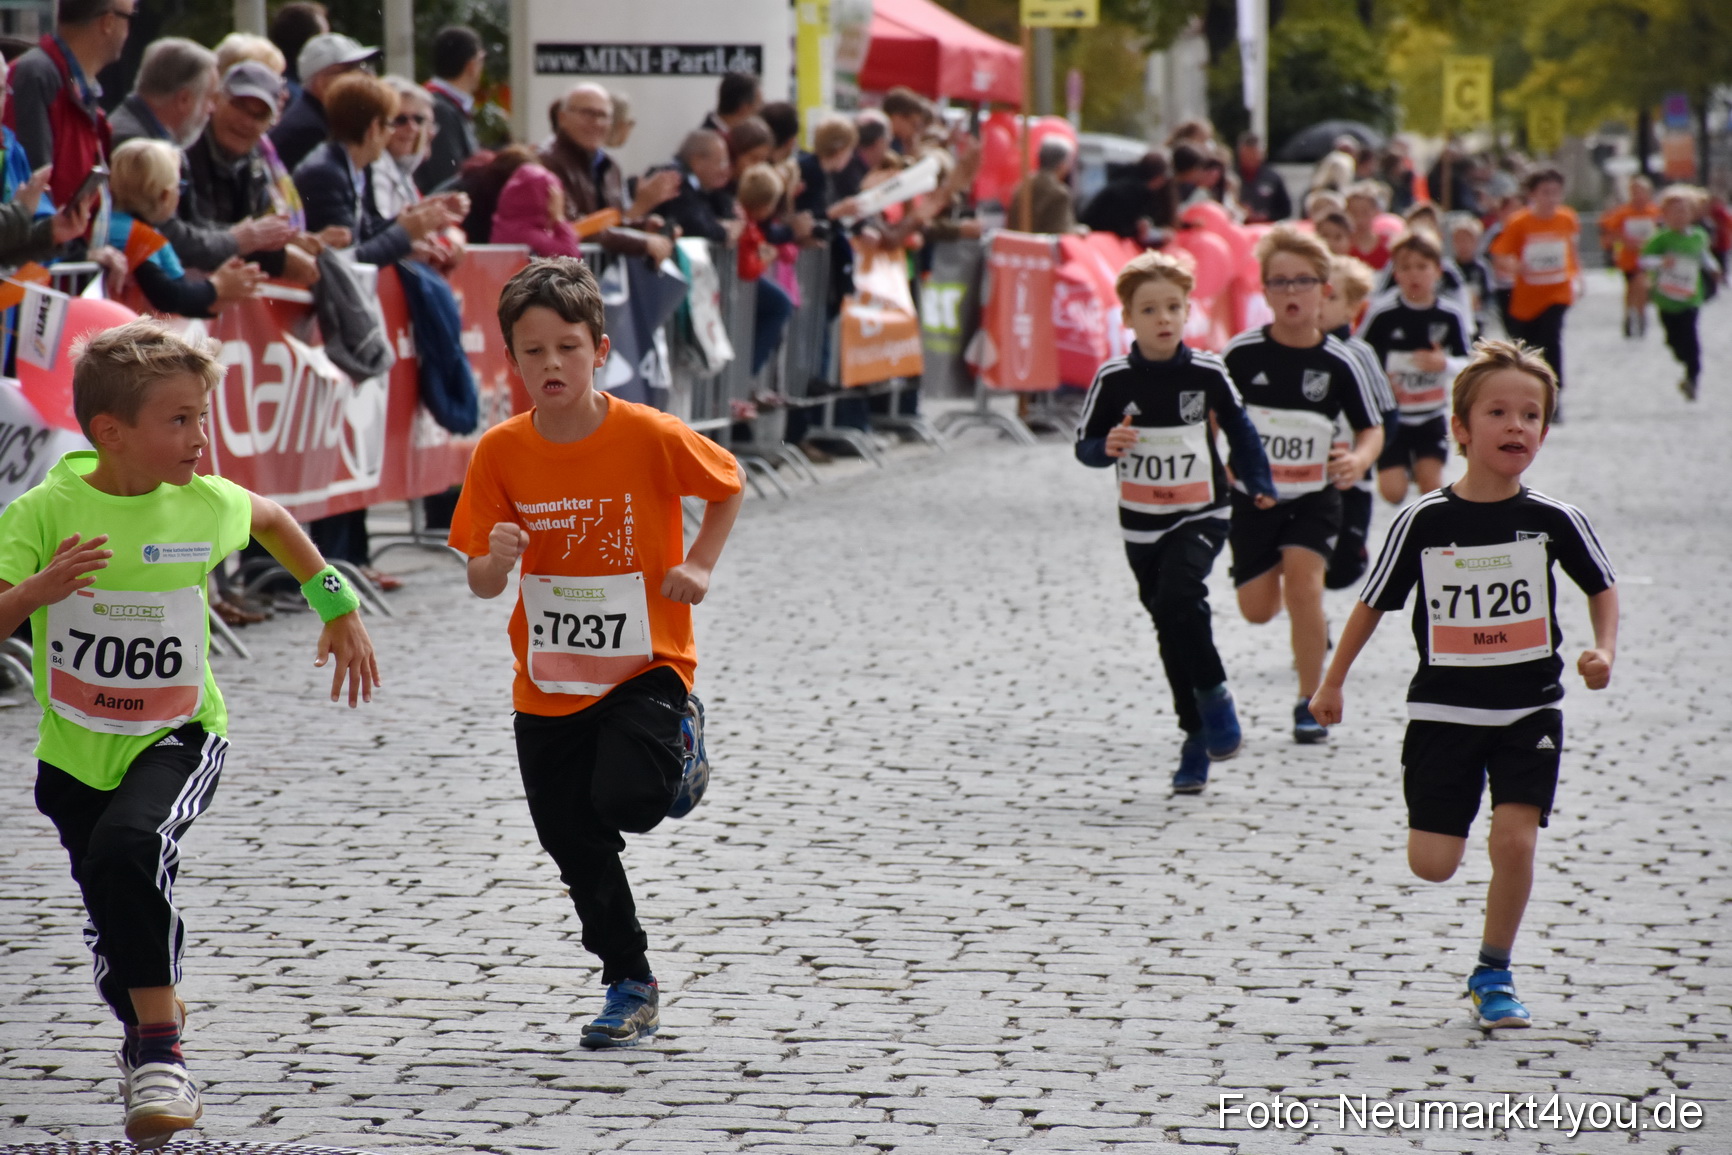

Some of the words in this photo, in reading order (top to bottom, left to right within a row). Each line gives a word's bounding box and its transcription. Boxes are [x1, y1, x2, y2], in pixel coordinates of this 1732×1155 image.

[536, 46, 757, 73] www.MINI-Partl.de
[1453, 78, 1479, 111] C
[1130, 453, 1196, 480] 7017
[515, 497, 594, 514] Neumarkter
[624, 493, 634, 566] BAMBINI
[1467, 555, 1512, 569] BOCK
[563, 587, 606, 599] BOCK
[1442, 579, 1532, 619] 7126
[110, 605, 165, 618] BOCK
[543, 610, 628, 650] 7237
[1473, 631, 1508, 645] Mark
[52, 655, 63, 665] B4
[68, 628, 183, 680] 7066
[94, 693, 144, 711] Aaron
